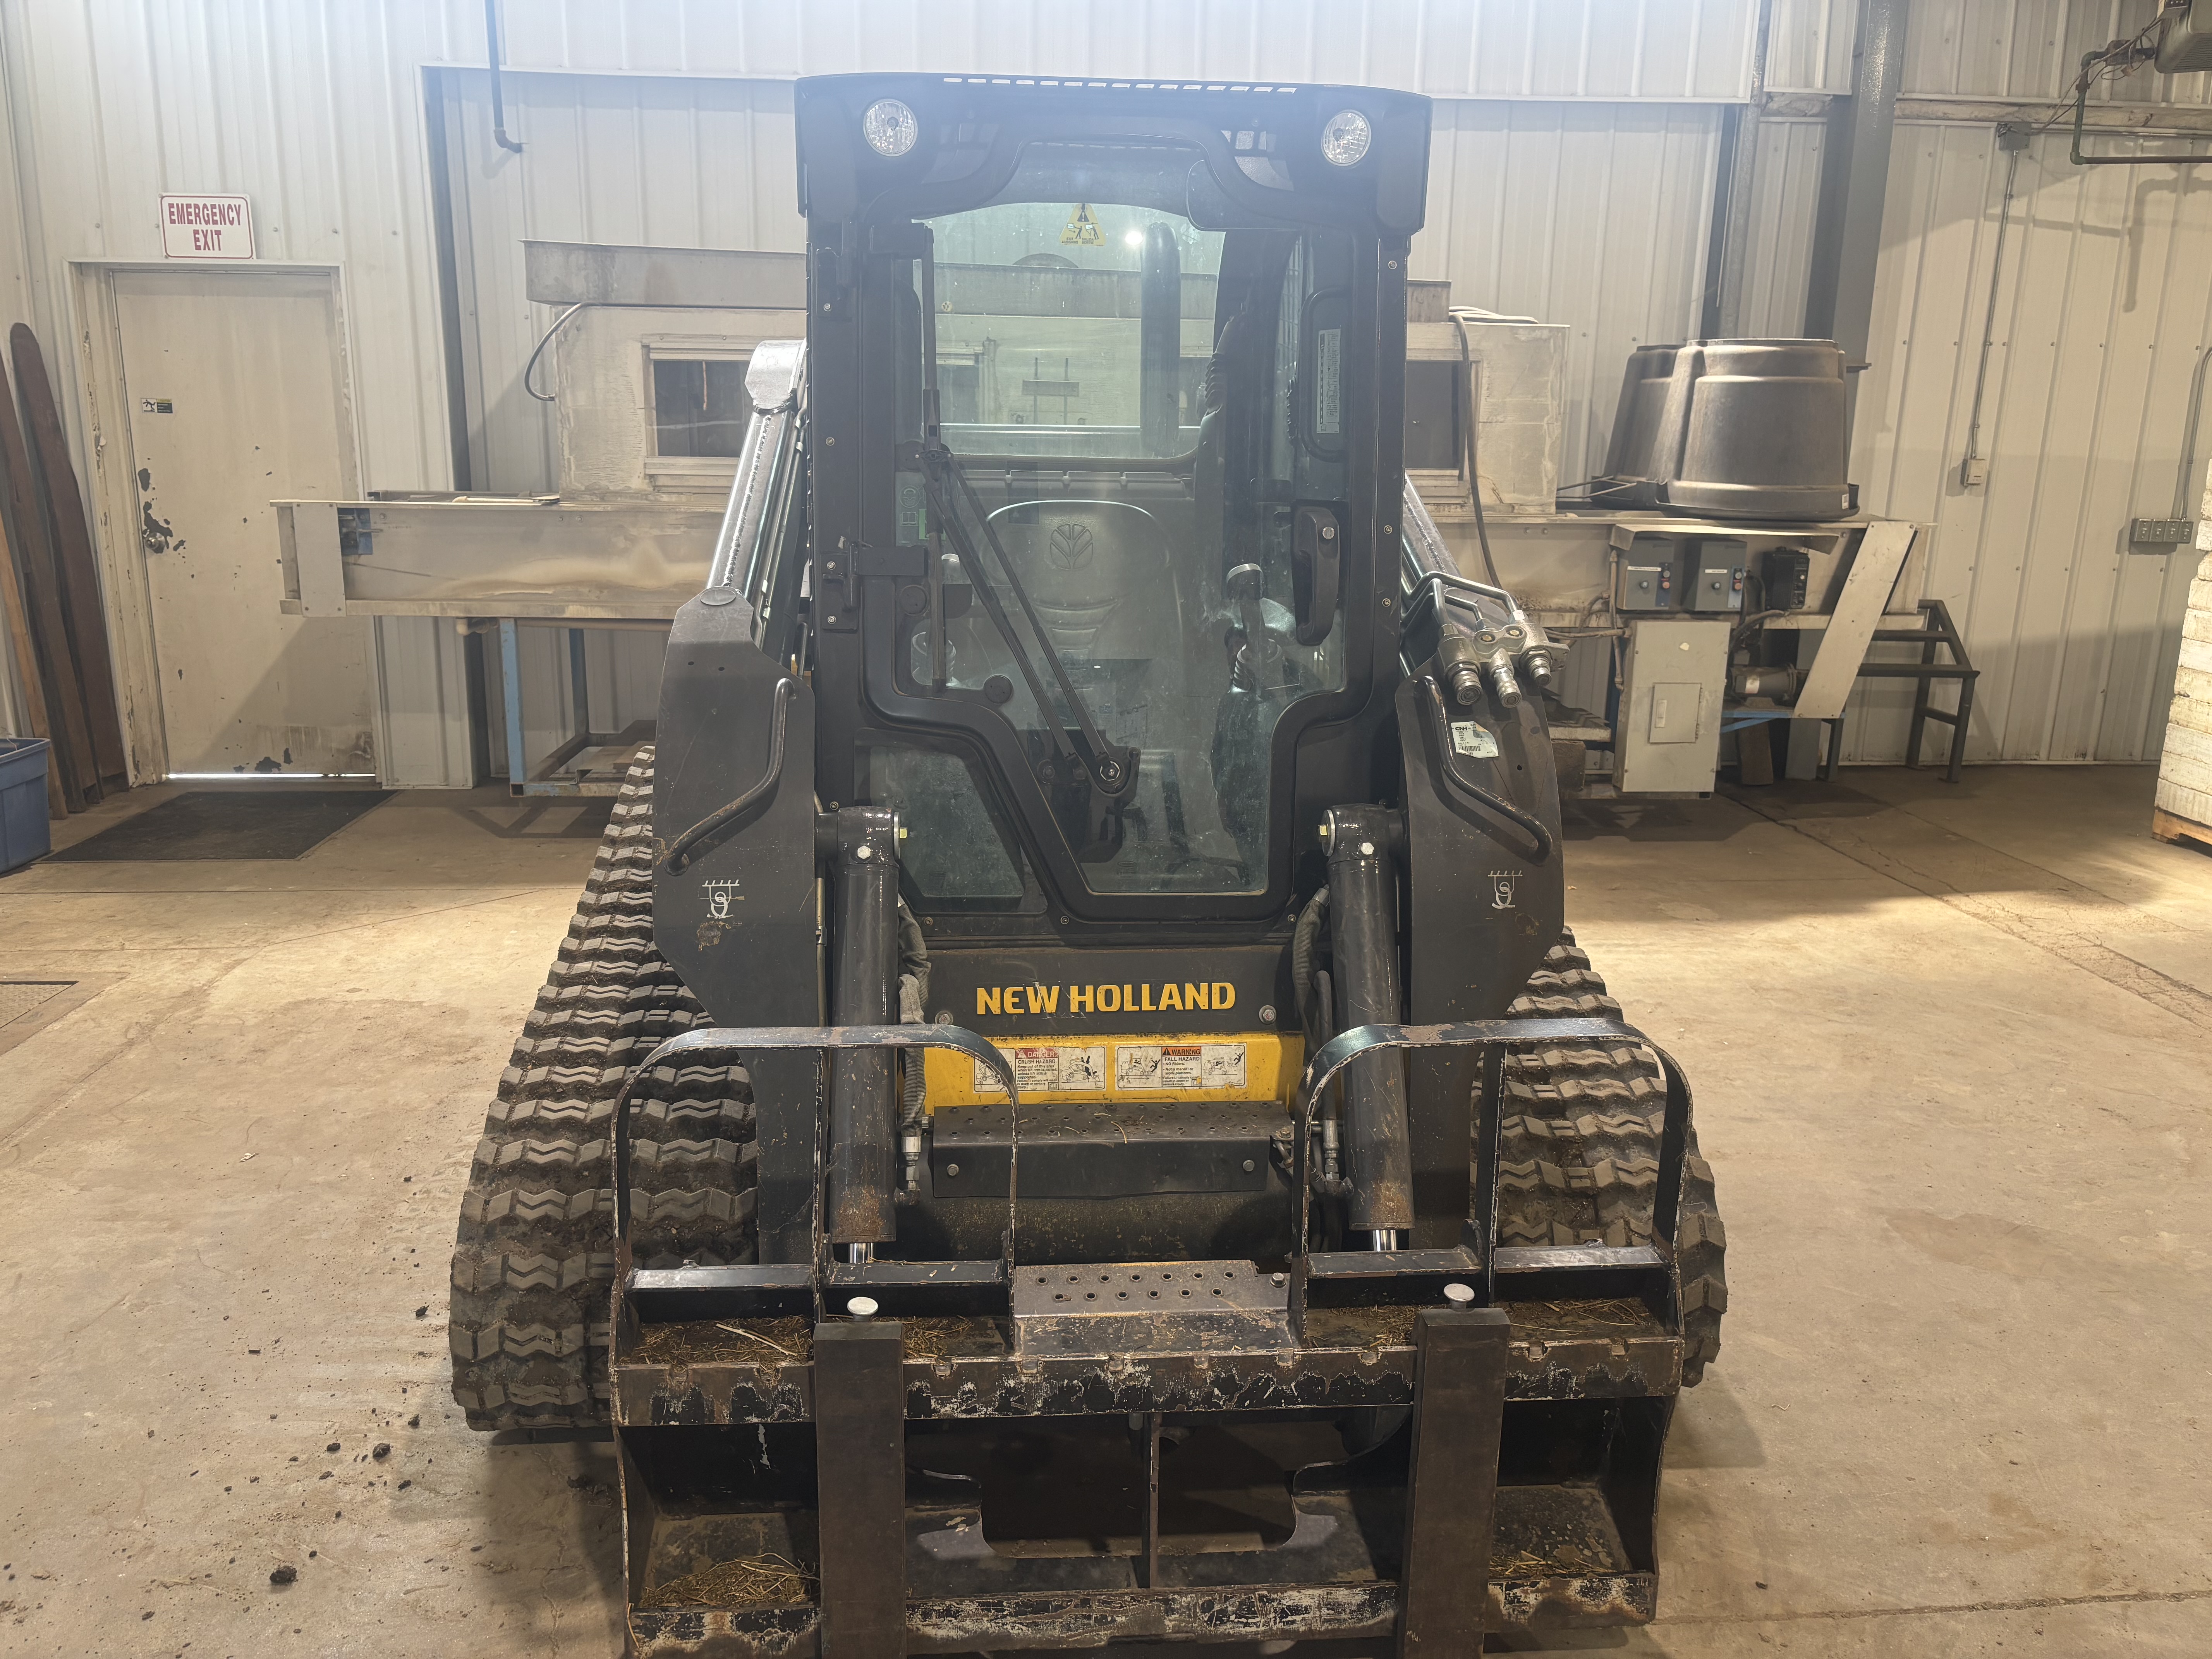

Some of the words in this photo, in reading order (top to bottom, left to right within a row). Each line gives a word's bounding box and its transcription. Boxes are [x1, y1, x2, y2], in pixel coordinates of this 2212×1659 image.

[168, 203, 241, 226] EMERGENCY
[193, 229, 222, 251] EXIT
[977, 985, 1060, 1015] NEW
[1070, 982, 1236, 1012] HOLLAND
